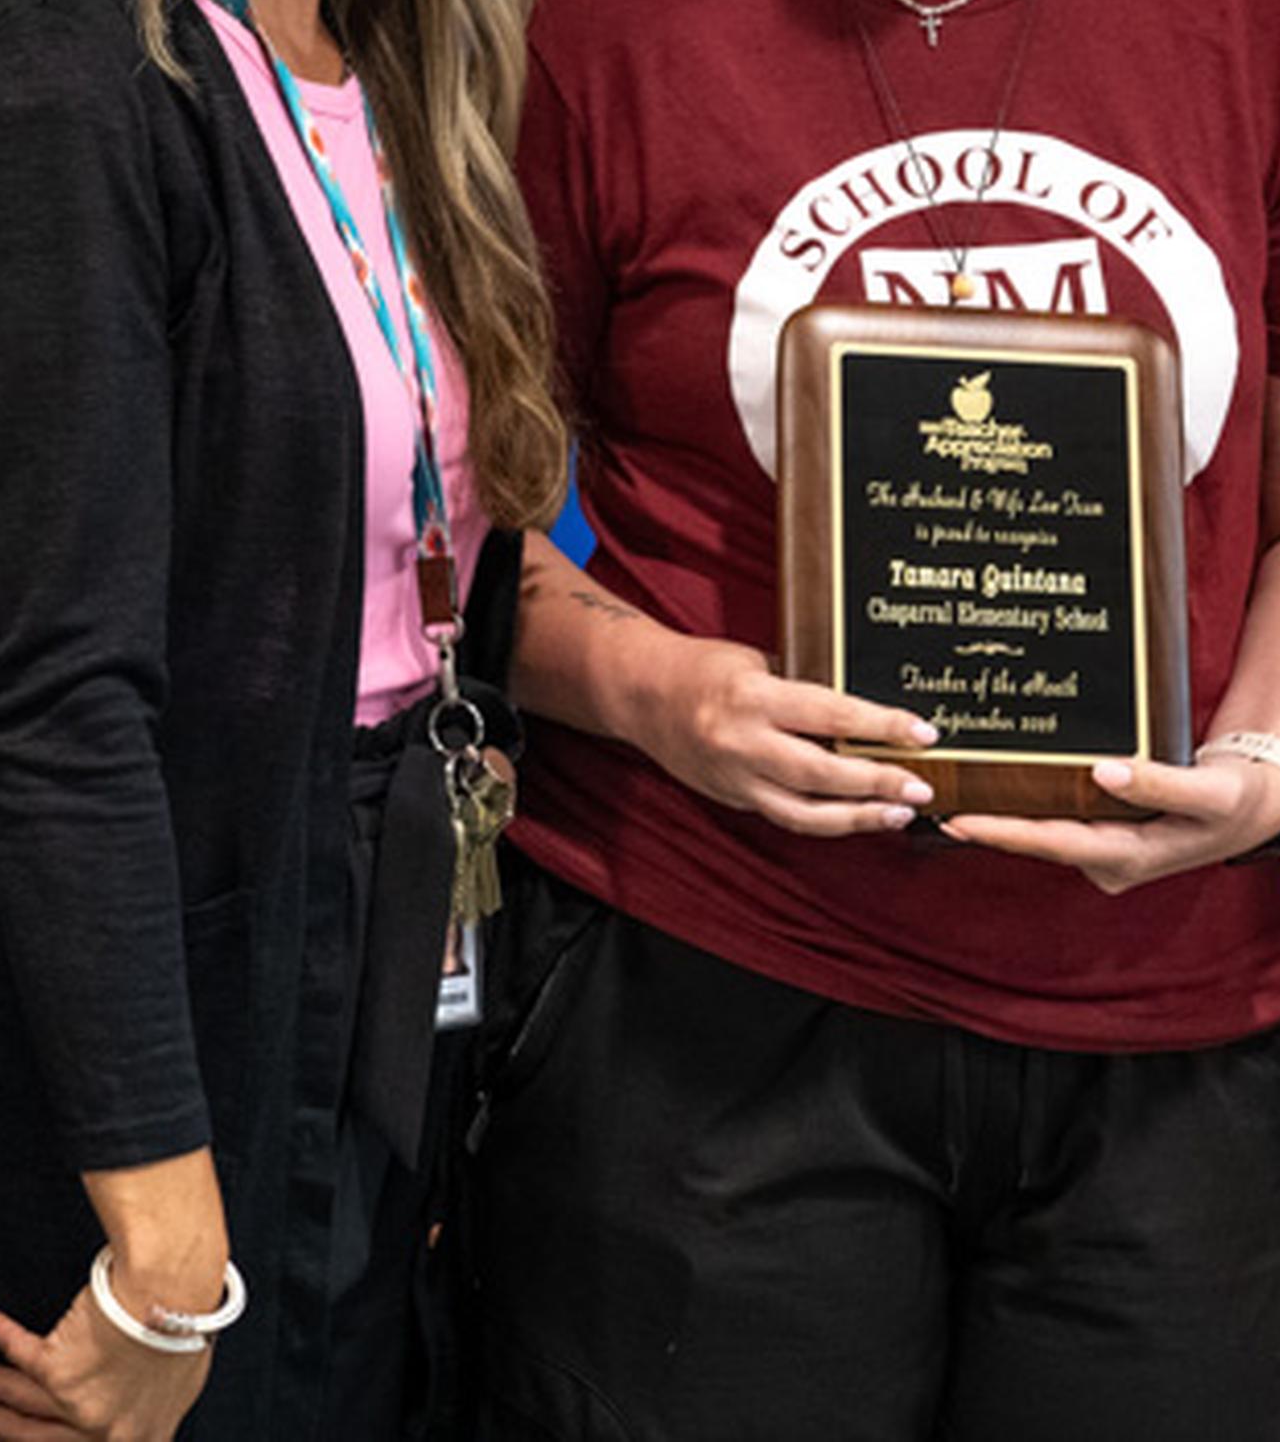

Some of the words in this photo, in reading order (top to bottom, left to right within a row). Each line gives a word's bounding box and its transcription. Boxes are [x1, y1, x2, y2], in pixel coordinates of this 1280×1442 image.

[778, 146, 1053, 273] SCHOOL
[1079, 179, 1173, 248] OF
[866, 480, 897, 507] The
[901, 482, 967, 509] Husband
[986, 487, 1024, 519] Wife
[1027, 490, 1061, 515] Law
[1062, 489, 1105, 517] Team
[915, 523, 929, 541] is
[931, 520, 973, 548] proud
[975, 525, 991, 543] to
[888, 560, 975, 592] Tamara
[981, 563, 1087, 599] Quintana
[866, 597, 953, 628] Chaparral
[957, 601, 1049, 635] Elementary
[1054, 605, 1109, 632] School
[901, 663, 967, 693] Teacher
[972, 666, 991, 703] of
[992, 667, 1016, 695] the
[1020, 670, 1078, 698] Month
[929, 703, 1016, 737] September
